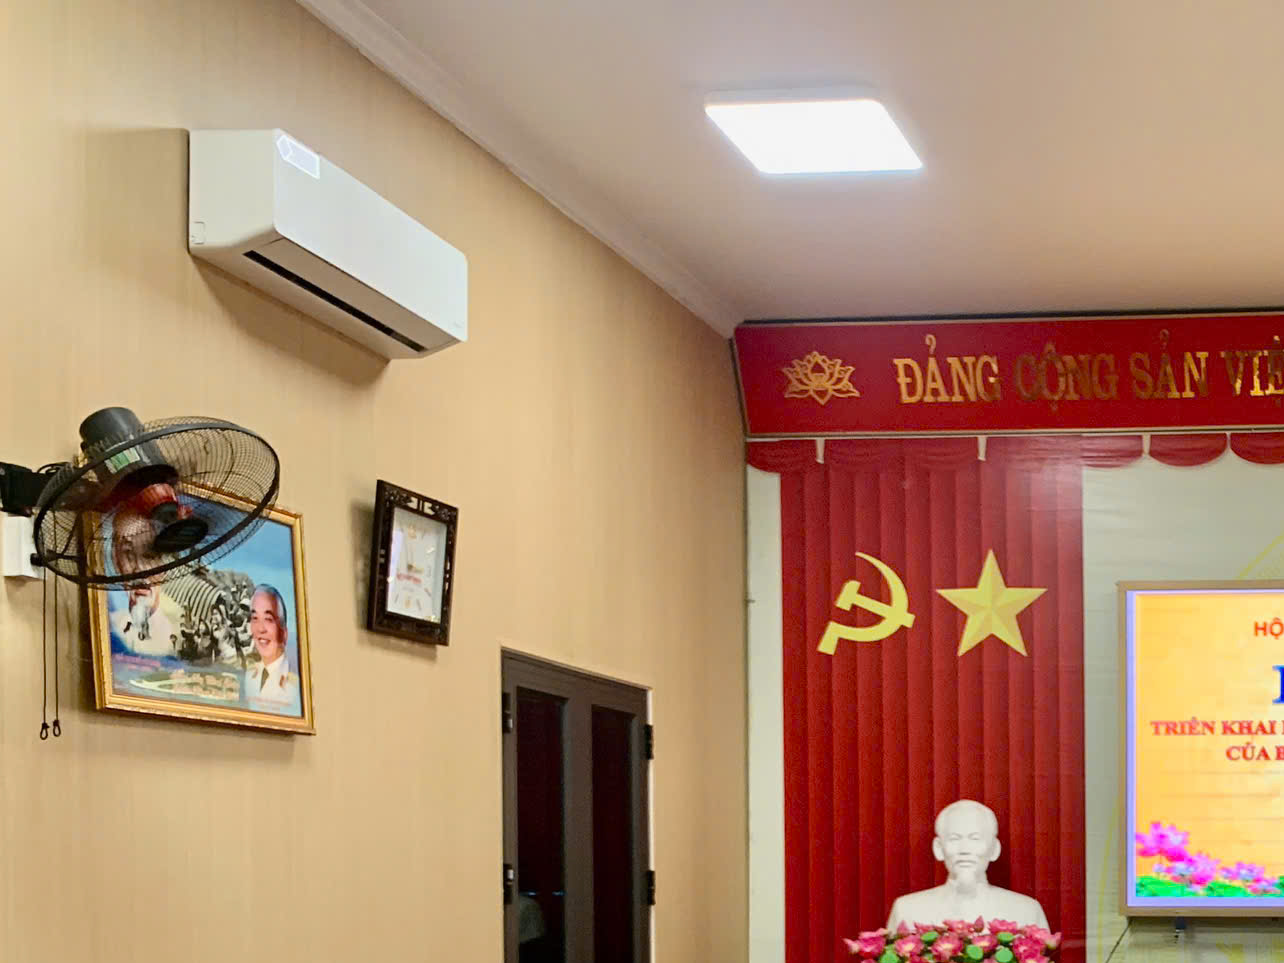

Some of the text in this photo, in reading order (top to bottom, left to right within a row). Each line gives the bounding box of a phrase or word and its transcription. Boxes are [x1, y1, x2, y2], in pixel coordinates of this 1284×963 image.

[893, 334, 1002, 404] ĐẢNG
[1013, 341, 1119, 412] CỘNG
[1130, 329, 1209, 400] SẢN
[1221, 719, 1277, 736] KHAI
[1225, 741, 1270, 761] CỦA
